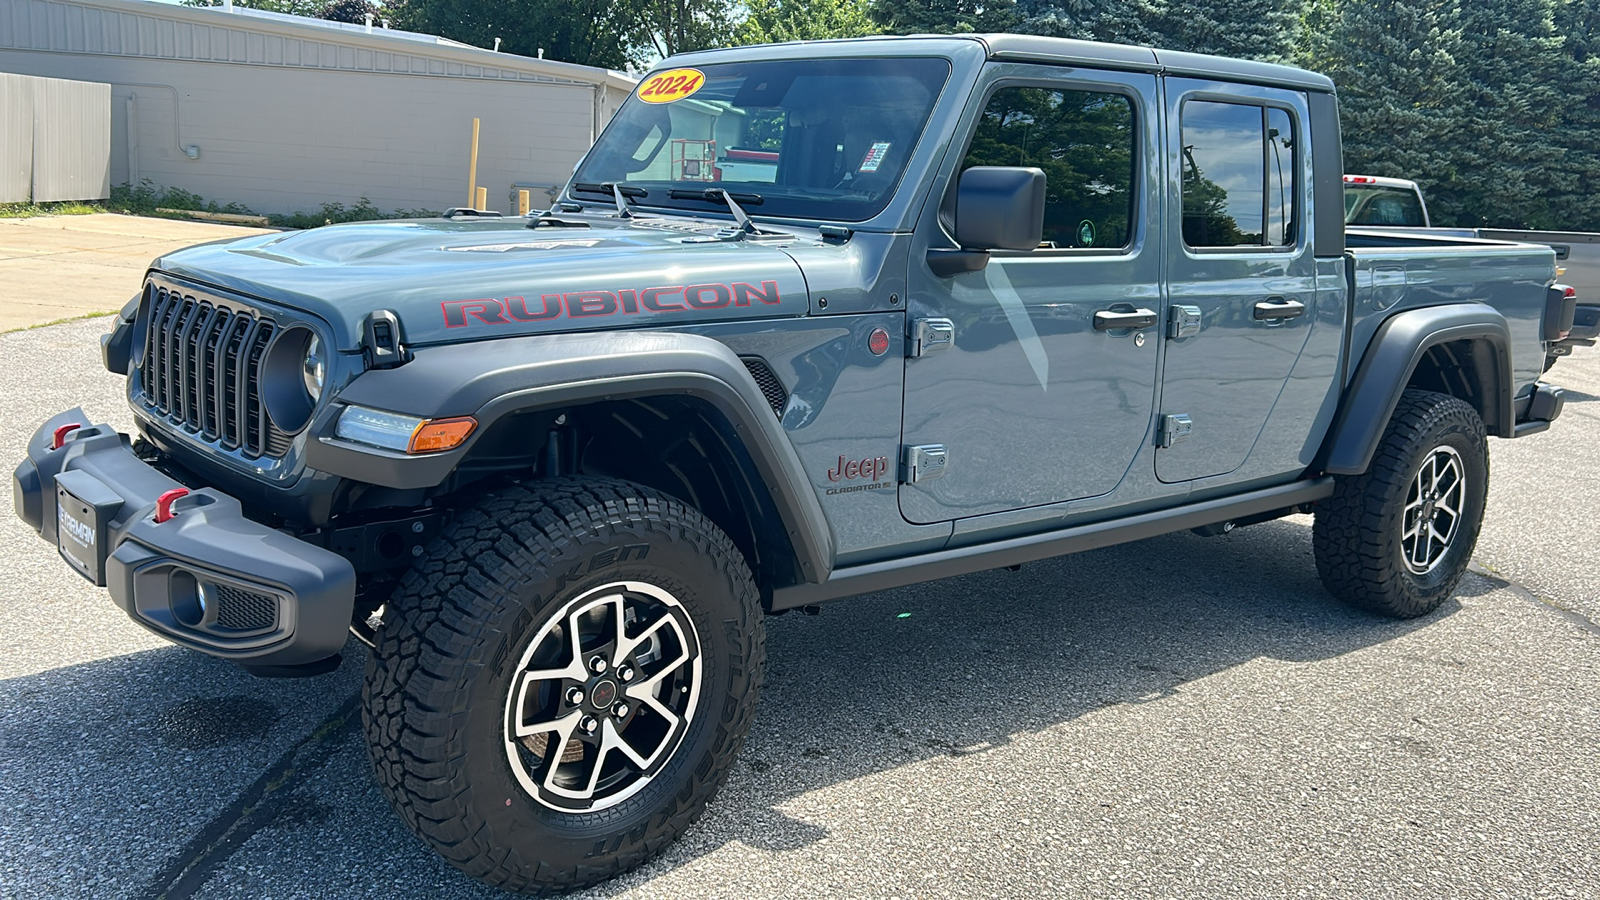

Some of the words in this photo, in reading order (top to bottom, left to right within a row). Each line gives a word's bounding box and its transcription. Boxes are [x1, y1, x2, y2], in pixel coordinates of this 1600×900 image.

[641, 75, 701, 96] 2024
[440, 280, 780, 329] RUBICON
[828, 455, 889, 482] Jeep
[827, 483, 881, 496] GLADIATOR
